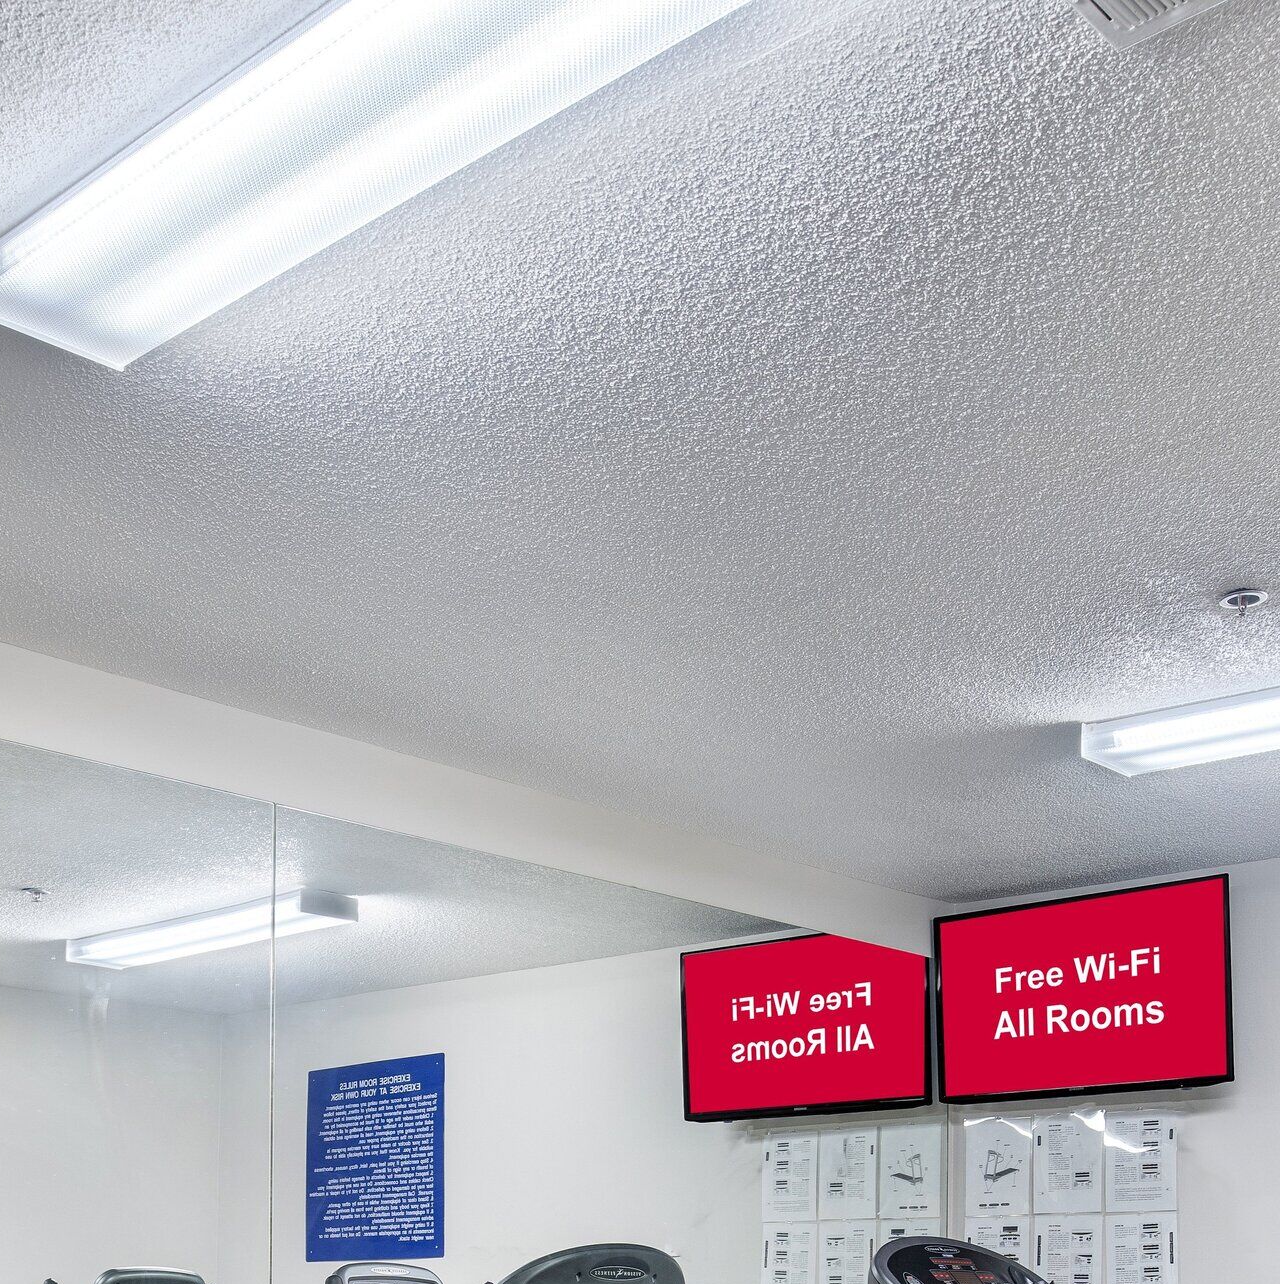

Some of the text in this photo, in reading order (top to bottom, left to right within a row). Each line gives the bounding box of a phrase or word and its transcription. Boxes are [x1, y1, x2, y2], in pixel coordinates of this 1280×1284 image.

[995, 946, 1161, 994] Free Wi-Fi
[993, 1000, 1165, 1040] All Rooms
